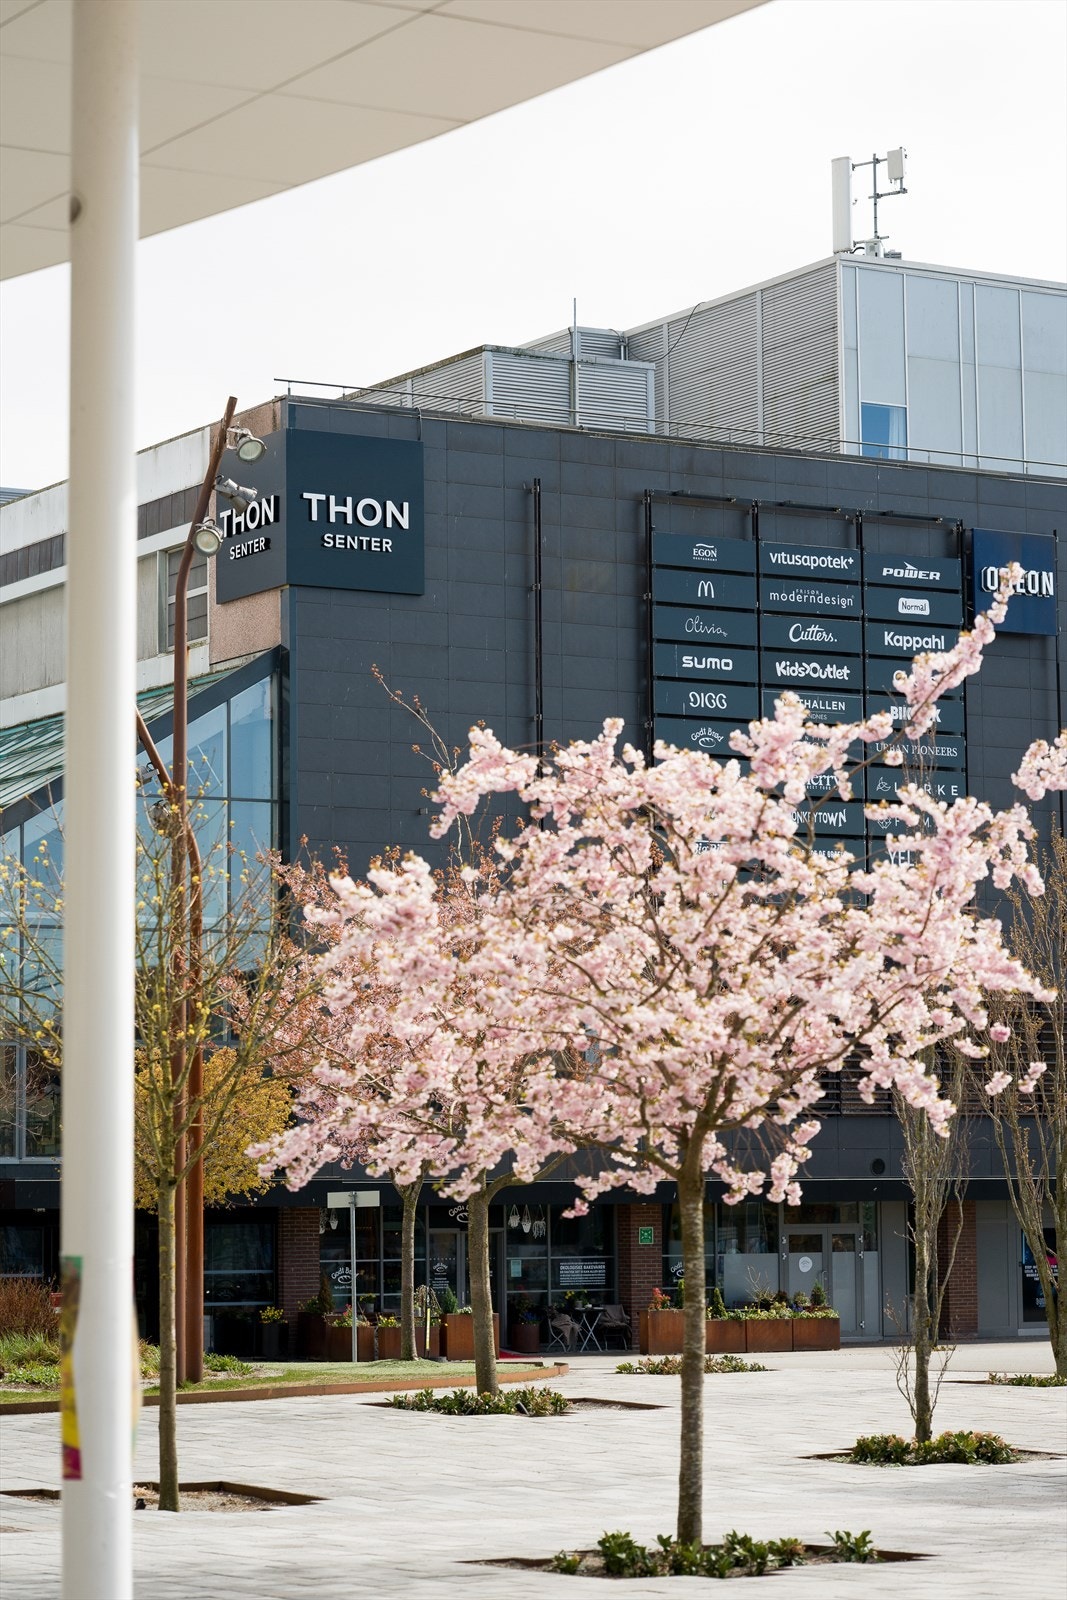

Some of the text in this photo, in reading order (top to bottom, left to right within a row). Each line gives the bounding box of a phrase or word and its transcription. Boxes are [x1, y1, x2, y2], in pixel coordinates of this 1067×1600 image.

[219, 494, 275, 538] THON
[303, 491, 410, 530] THON
[229, 536, 266, 561] SENTER
[323, 532, 393, 553] SENTER
[692, 547, 718, 558] EGON
[882, 561, 941, 581] POWER
[982, 566, 1054, 598] OEON
[901, 600, 927, 613] Normal
[884, 631, 945, 651] Kappahl
[690, 726, 706, 741] Godt
[894, 782, 959, 796] LRKE
[331, 1266, 345, 1279] Godt
